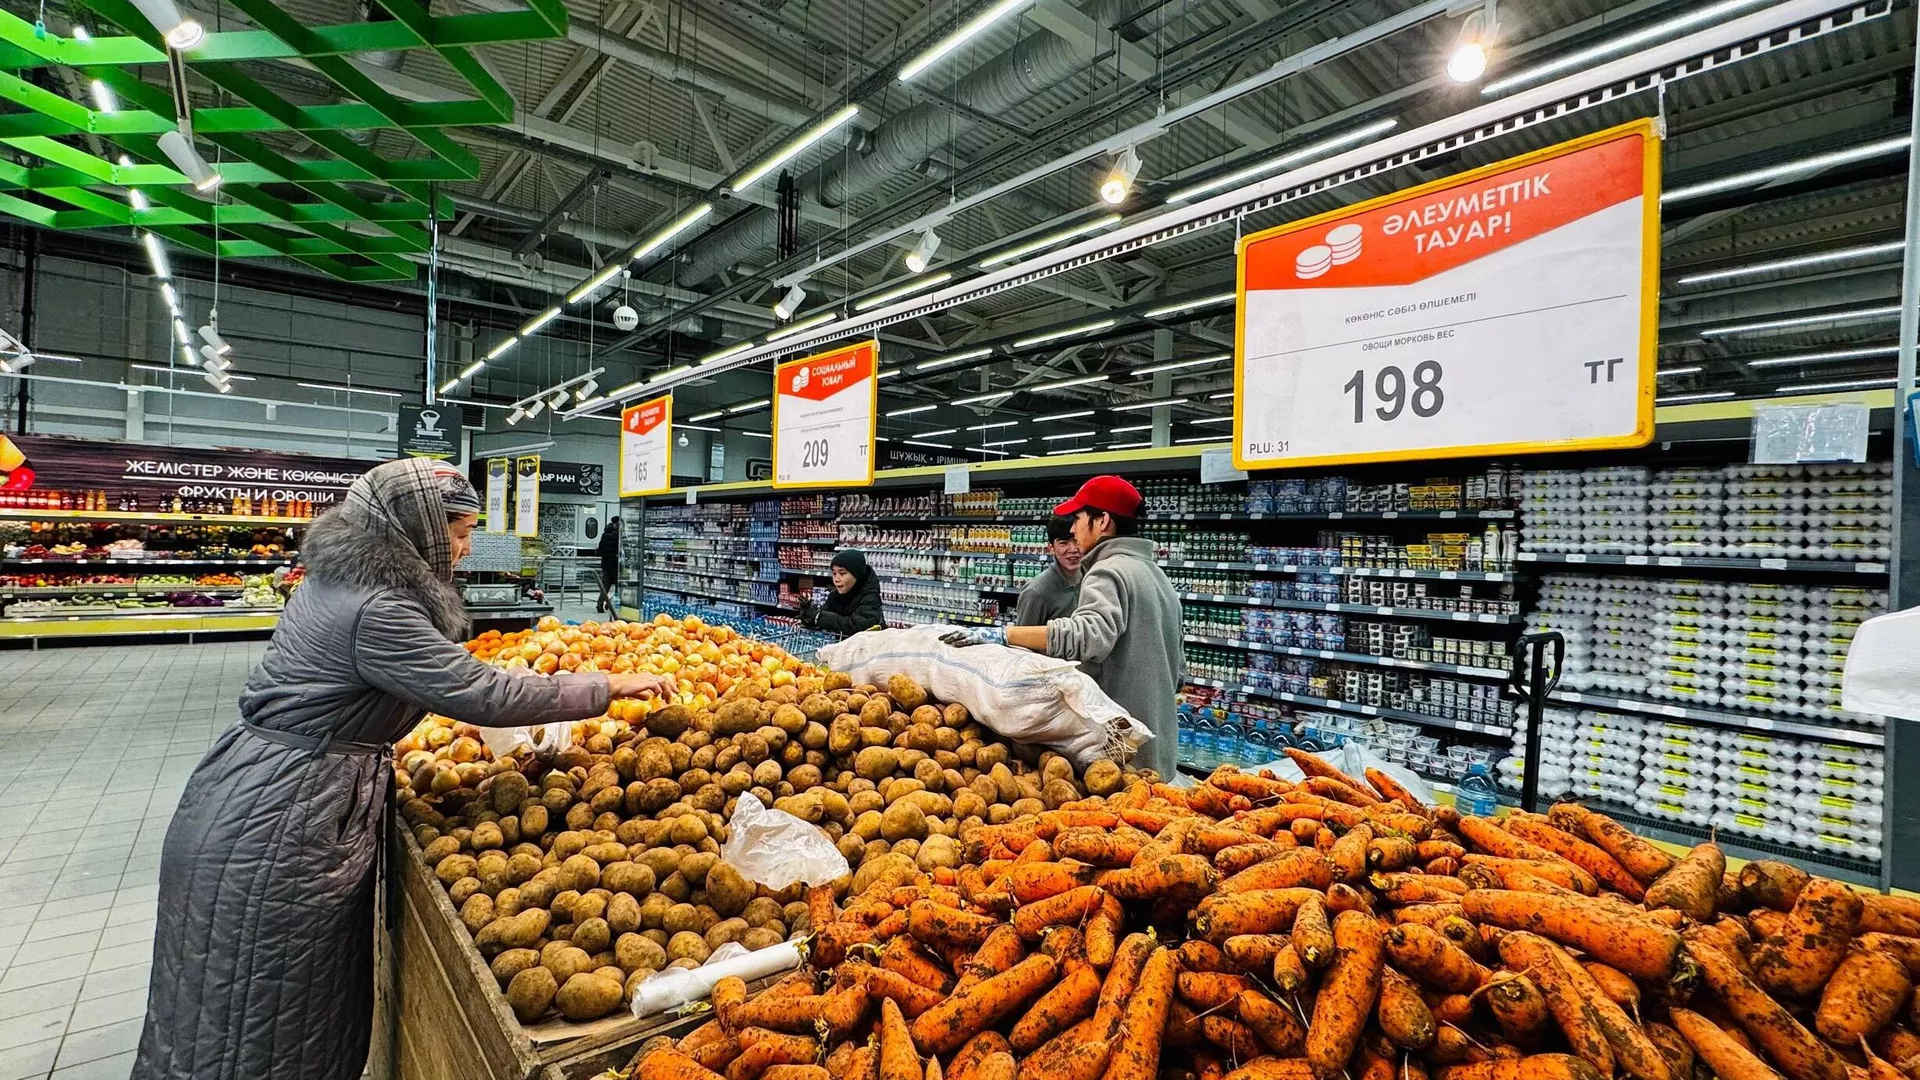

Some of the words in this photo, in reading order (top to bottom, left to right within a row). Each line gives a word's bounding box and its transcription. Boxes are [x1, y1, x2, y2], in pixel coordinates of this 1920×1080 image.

[1382, 172, 1551, 236] ӘЛЕУМЕТТІК
[1414, 211, 1511, 254] ТАУАР!
[1345, 310, 1385, 324] КӨКӨНІС
[1387, 304, 1417, 316] СӘБІЗ
[1419, 292, 1477, 310] ӨЛШЕМЕЛІ
[1362, 340, 1392, 352] ОВОЩИ
[1394, 334, 1435, 347] МОРКОВЬ
[1437, 329, 1455, 339] ВЕС
[812, 357, 856, 376] СОЦИАЛЬНЫЙ
[822, 375, 843, 387] ТОВАР!
[1344, 360, 1444, 424] 198
[802, 438, 829, 468] 209
[1249, 442, 1274, 455] PLU:
[1278, 441, 1289, 452] 31
[126, 459, 223, 477] ЖЕМІСТЕР
[227, 465, 279, 481] ЖӘНЕ
[538, 474, 555, 483] ДЫР
[556, 474, 576, 483] НАН
[635, 461, 648, 482] 165
[178, 485, 249, 501] ФРУКТЫ
[255, 489, 268, 501] И
